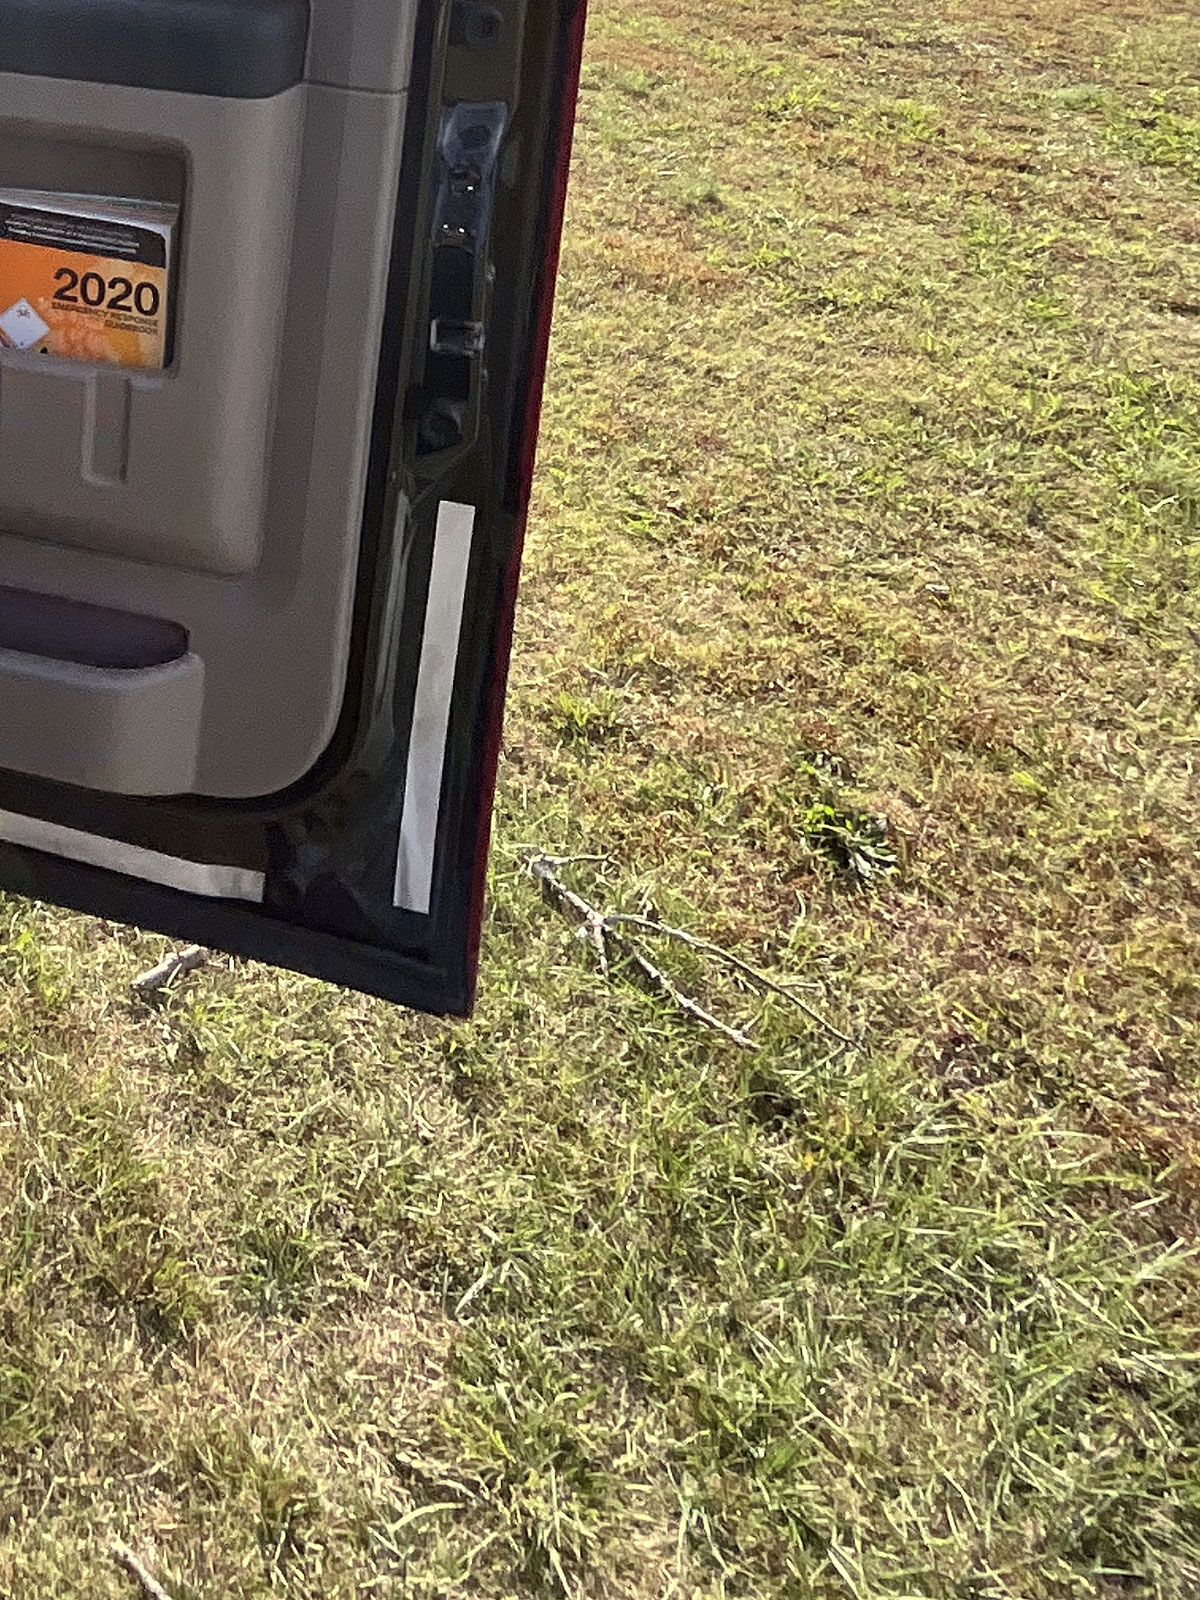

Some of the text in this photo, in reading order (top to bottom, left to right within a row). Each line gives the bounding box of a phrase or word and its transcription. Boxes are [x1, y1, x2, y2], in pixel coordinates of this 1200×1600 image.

[53, 267, 160, 316] 2020
[52, 302, 160, 326] EMERGENCY RESPONSE
